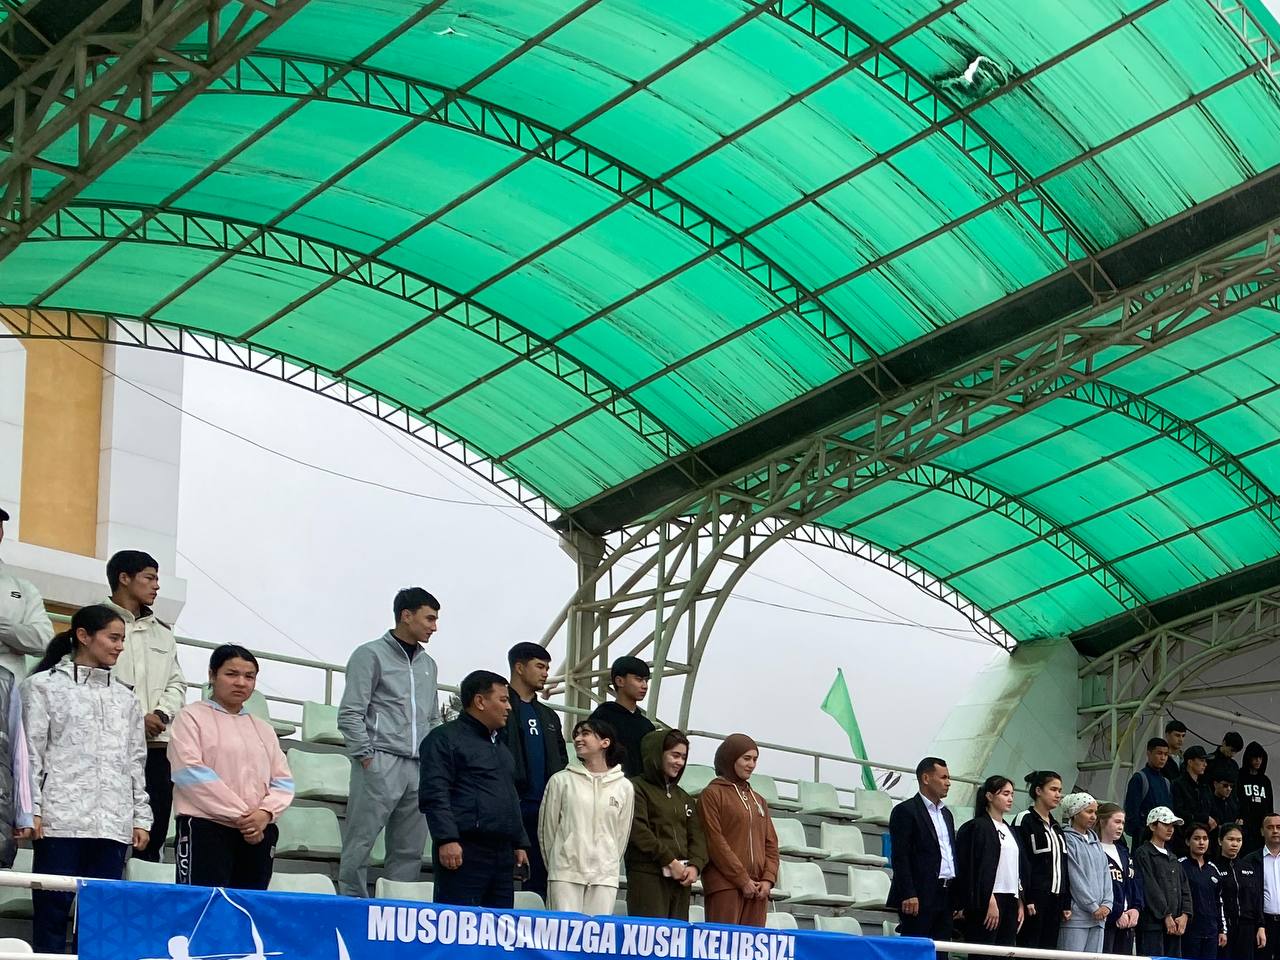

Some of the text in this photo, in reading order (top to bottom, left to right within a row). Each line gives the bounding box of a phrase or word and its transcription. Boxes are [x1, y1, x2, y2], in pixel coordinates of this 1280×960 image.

[1244, 784, 1266, 799] USA
[368, 905, 616, 955] MUSOBAQAMIZGA
[621, 923, 687, 958] XUSH
